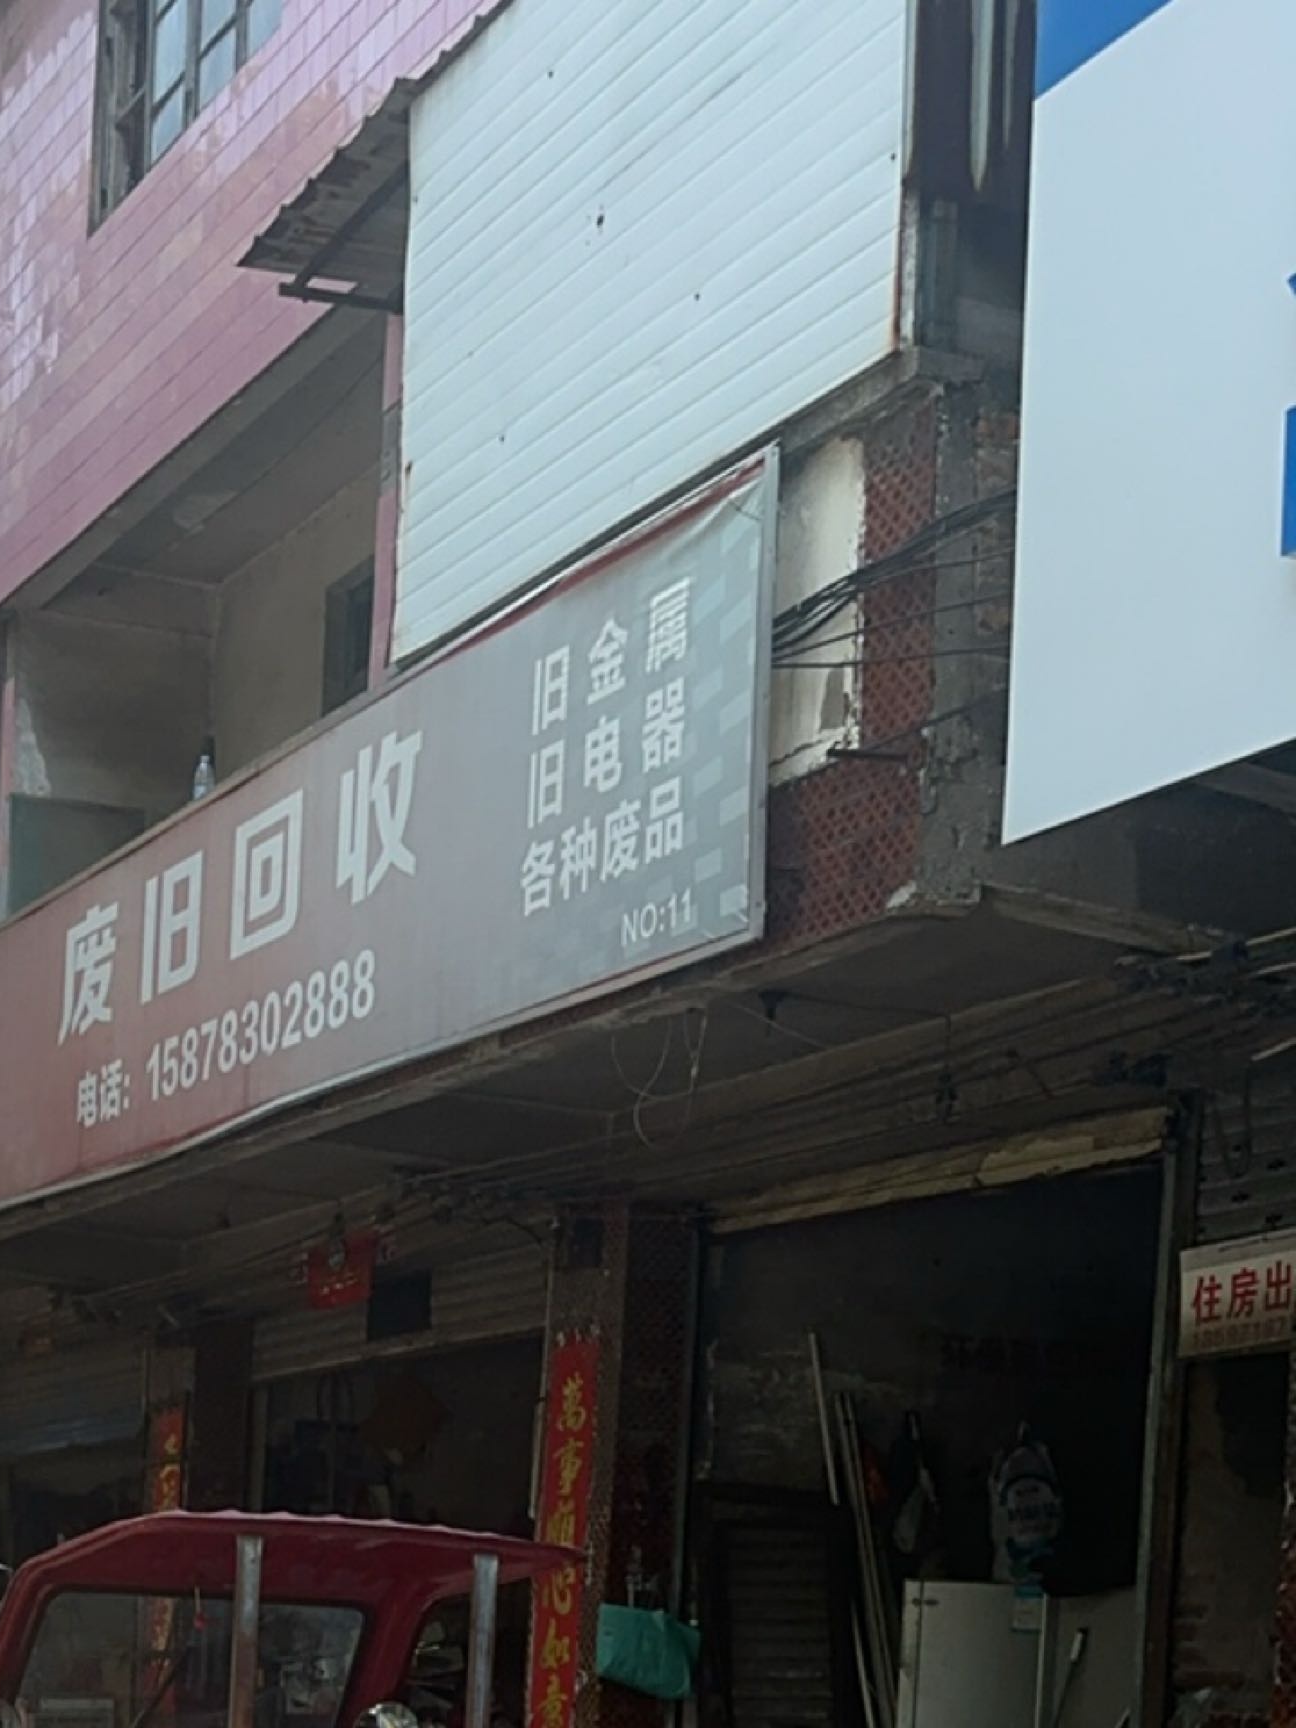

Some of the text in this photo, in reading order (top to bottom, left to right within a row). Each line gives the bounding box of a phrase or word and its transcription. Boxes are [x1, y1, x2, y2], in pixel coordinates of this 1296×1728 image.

[532, 577, 691, 736] 旧金属
[527, 677, 685, 829] 旧电器
[57, 730, 424, 1046] 废旧回收
[520, 776, 685, 916] 各种废品
[620, 888, 692, 947] NO:11
[1191, 1260, 1296, 1326] 住房出
